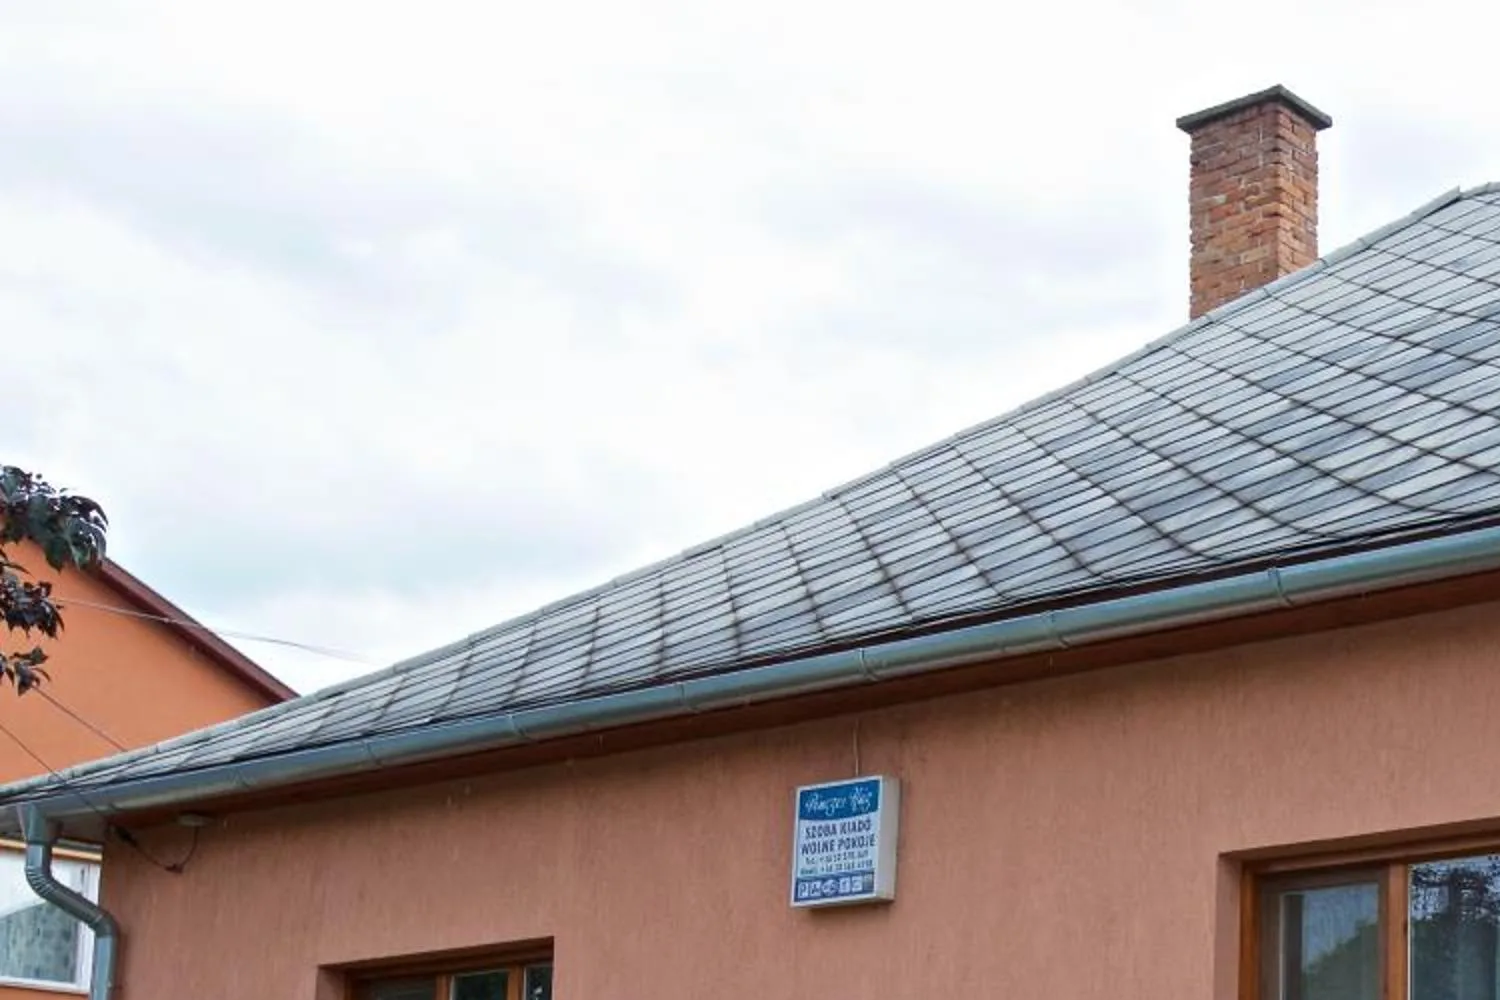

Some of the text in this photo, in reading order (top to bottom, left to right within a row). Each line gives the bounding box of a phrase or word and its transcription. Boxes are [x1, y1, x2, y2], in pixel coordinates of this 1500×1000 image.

[805, 818, 872, 840] SZOBA KIADÓ
[838, 833, 876, 850] POKOJE
